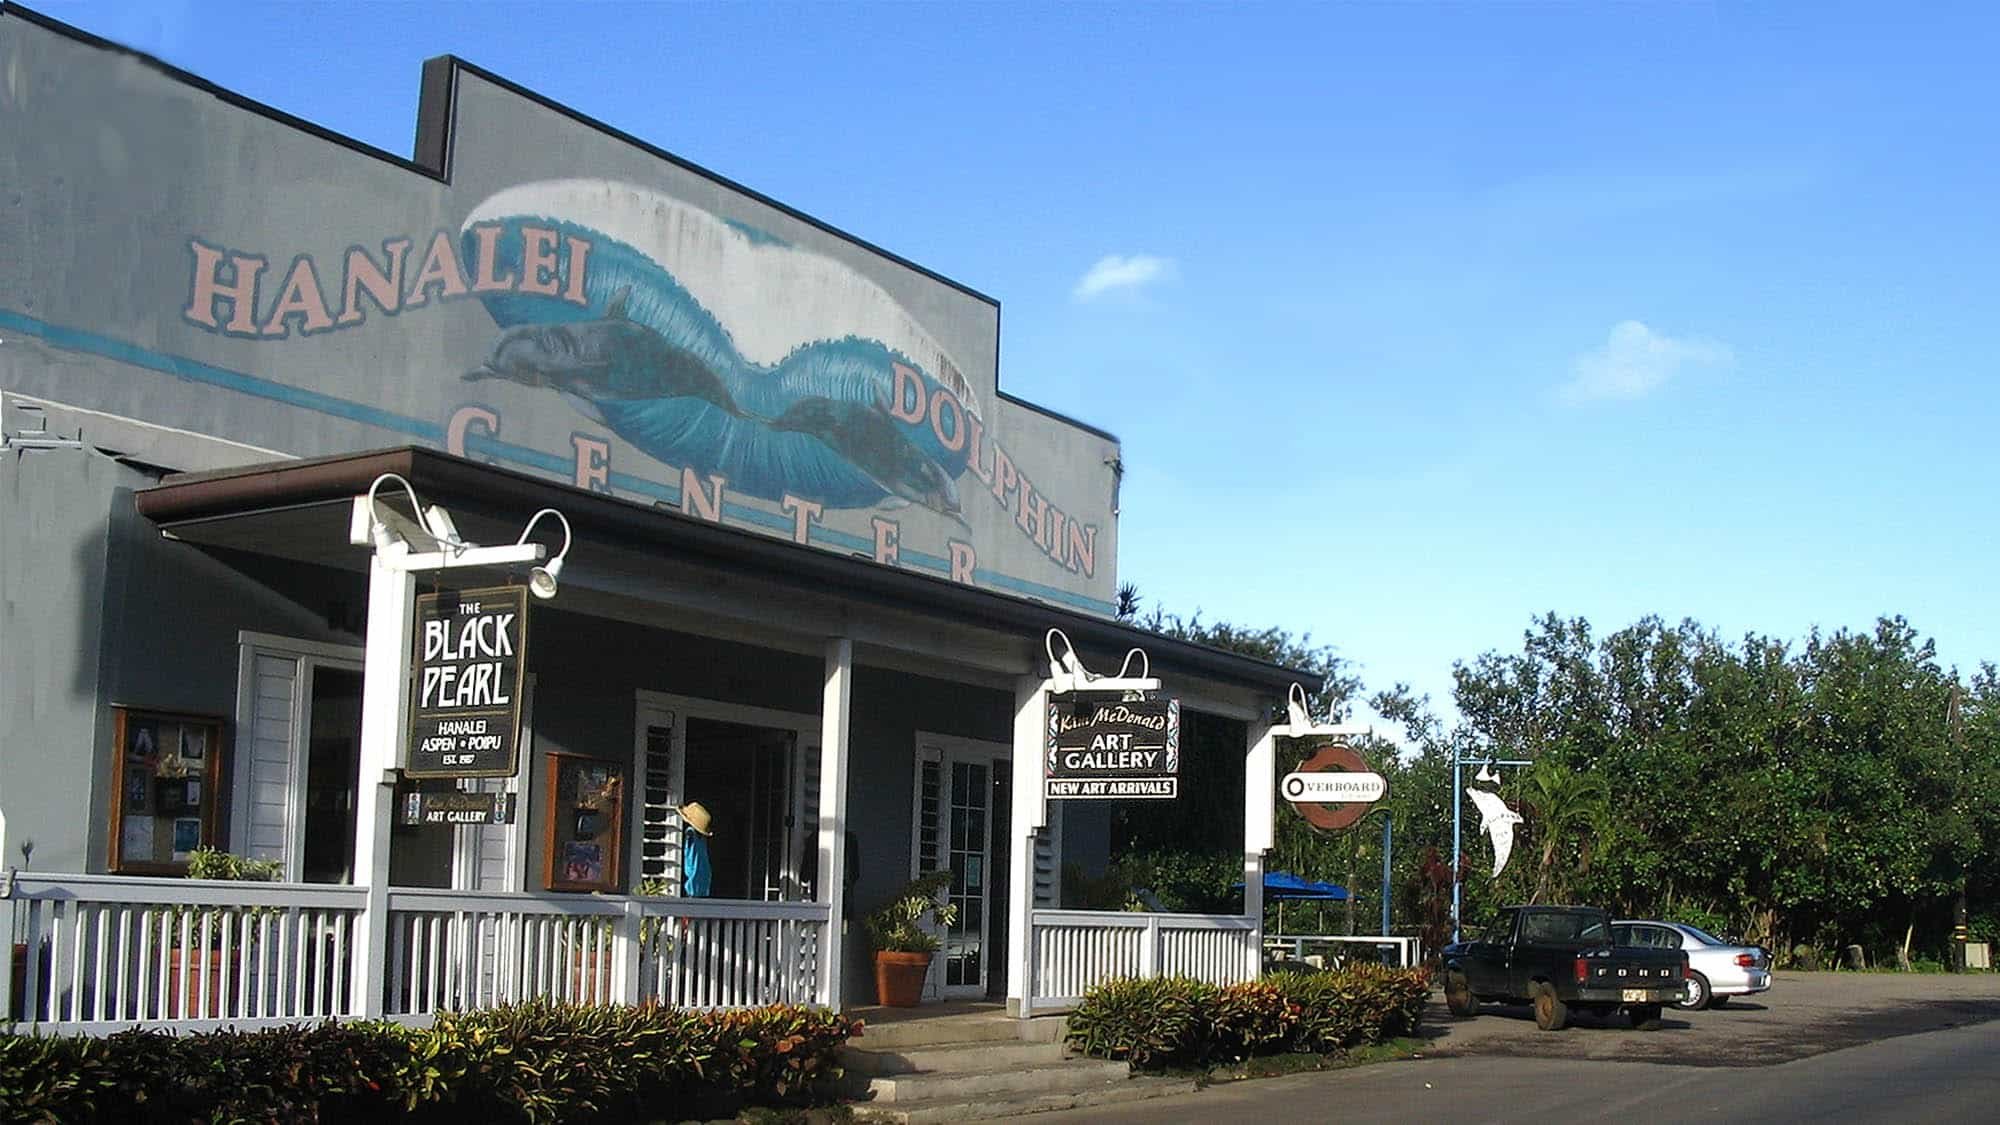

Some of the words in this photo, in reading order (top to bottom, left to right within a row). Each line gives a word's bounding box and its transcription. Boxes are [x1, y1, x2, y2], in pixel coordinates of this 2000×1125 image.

[185, 224, 592, 338] HANALEI
[890, 362, 1097, 577] DOLPHIN
[447, 407, 977, 587] CENTER
[459, 602, 481, 615] THE
[423, 613, 515, 662] BLACK
[421, 662, 510, 708] PEARL
[1090, 705, 1165, 730] McDonald
[438, 720, 487, 735] HANALEI
[421, 738, 457, 752] ASPEN
[467, 735, 502, 750] POIPU
[1090, 733, 1134, 751] ART
[1064, 751, 1158, 769] GALLERY
[1050, 782, 1080, 795] NEW
[1081, 782, 1108, 795] ART
[1108, 781, 1172, 794] ARRIVALS
[1287, 777, 1381, 797] OVERBOARD
[425, 811, 445, 823] ART
[446, 810, 488, 823] GALLERY
[1597, 967, 1670, 978] FORD
